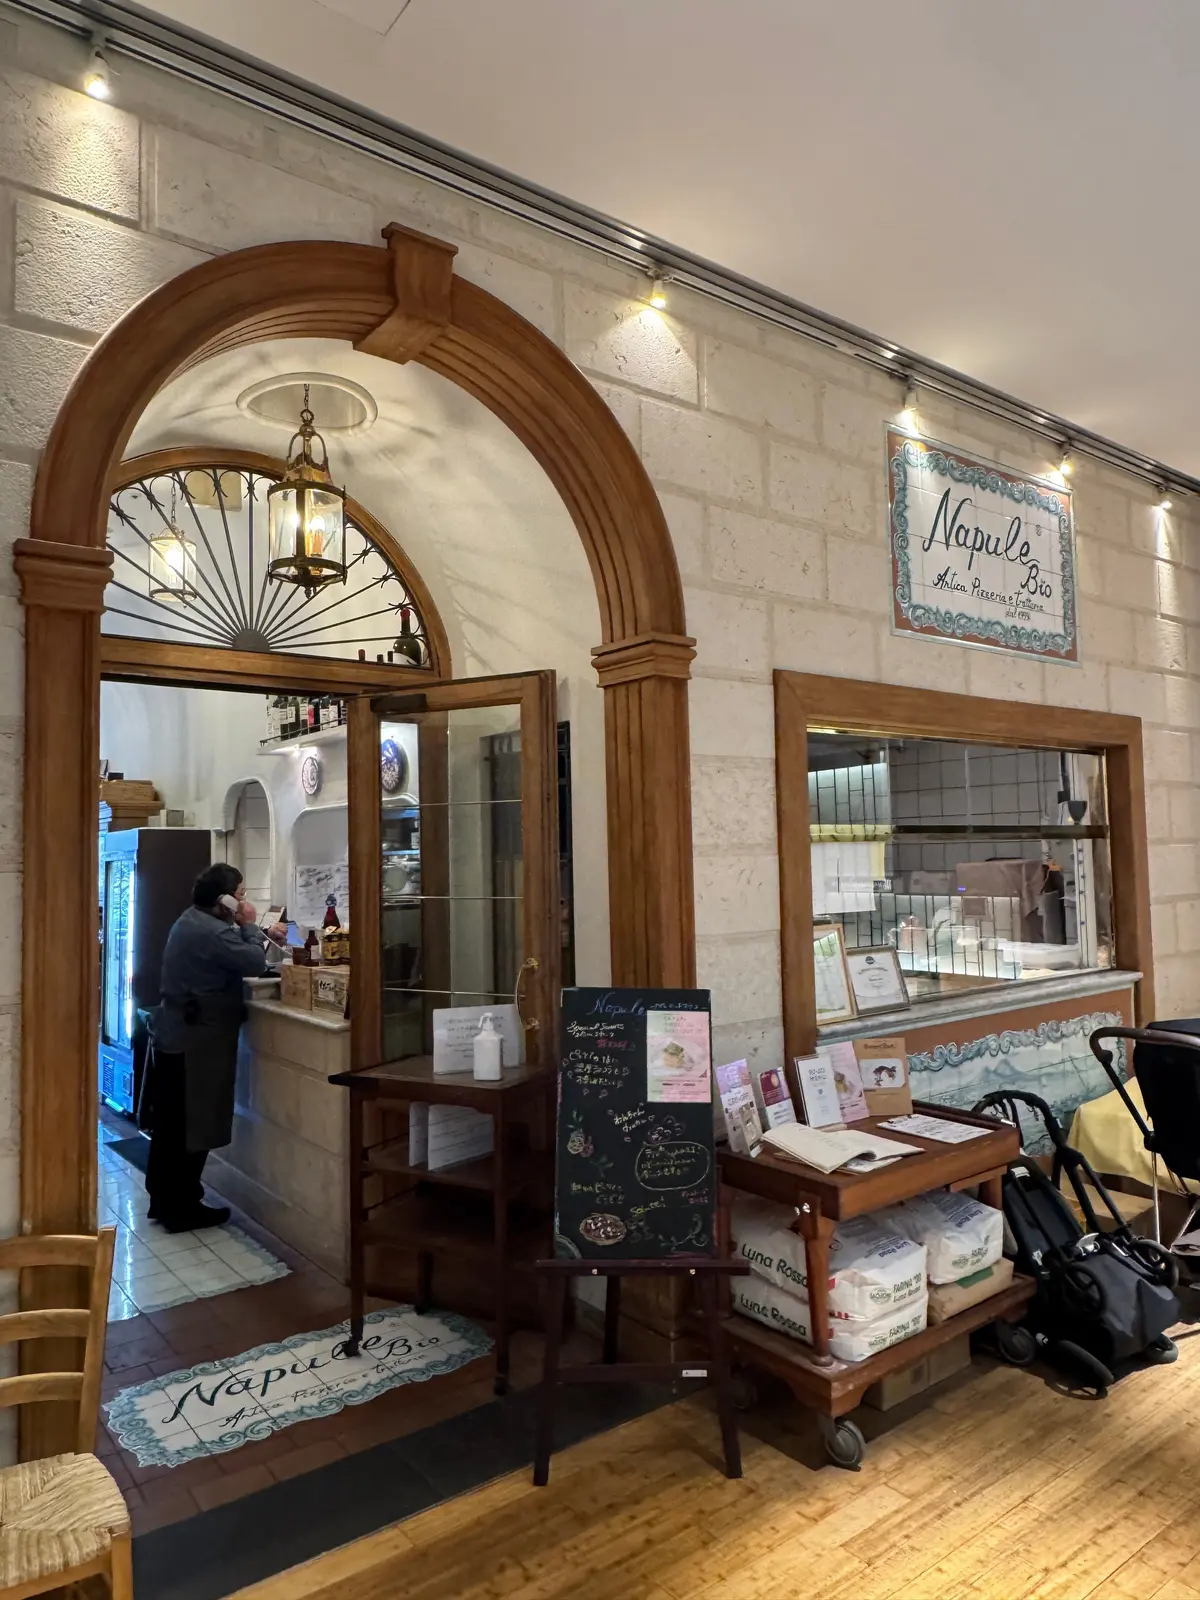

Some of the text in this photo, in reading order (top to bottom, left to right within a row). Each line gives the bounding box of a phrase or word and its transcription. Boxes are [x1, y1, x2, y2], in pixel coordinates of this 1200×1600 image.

[922, 487, 1040, 571] Napule
[1020, 563, 1052, 598] Bio
[741, 1243, 773, 1268] Luna
[740, 1293, 769, 1318] Luna
[378, 1336, 440, 1361] Bio
